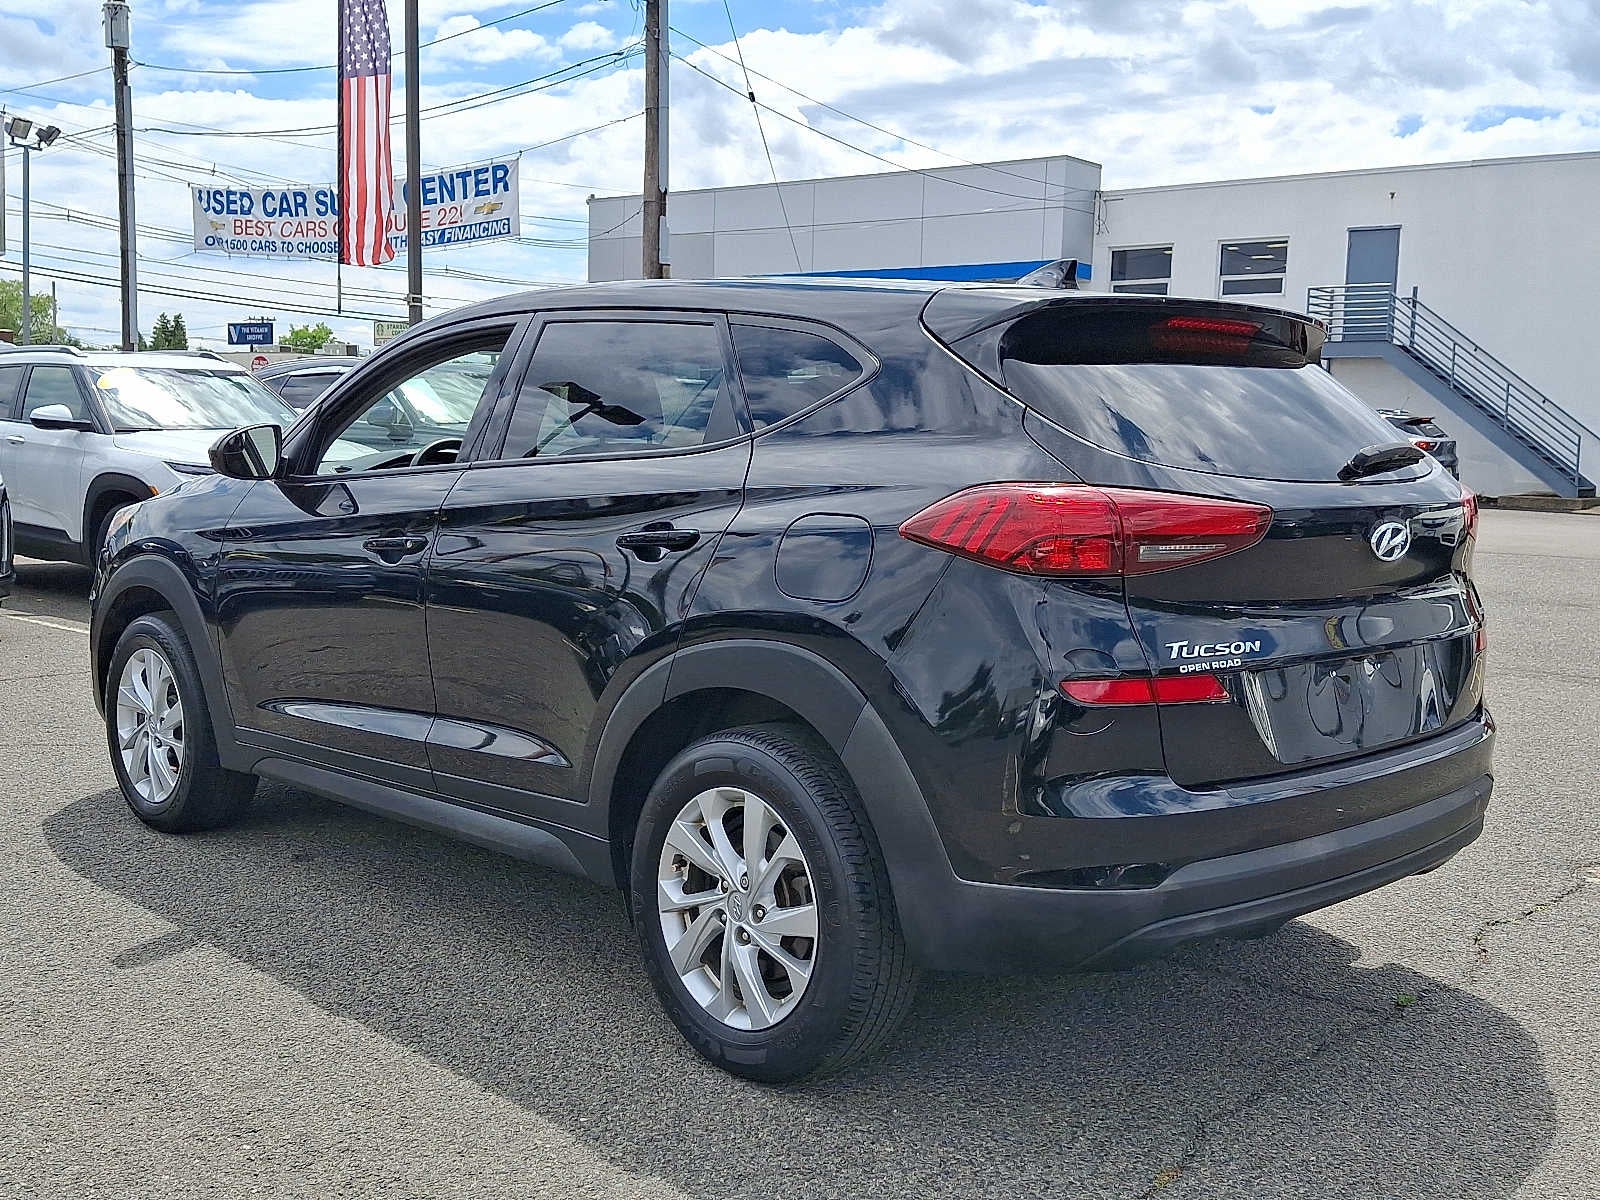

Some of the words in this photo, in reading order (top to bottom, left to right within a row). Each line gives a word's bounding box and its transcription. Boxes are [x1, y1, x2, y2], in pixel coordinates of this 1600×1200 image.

[198, 189, 254, 216] USED
[262, 191, 308, 218] CAR
[403, 164, 510, 206] ENTER
[225, 238, 248, 251] 1500
[250, 239, 278, 252] CARS
[280, 241, 294, 253] TO
[389, 235, 408, 249] ITH
[420, 230, 442, 246] ASY
[443, 219, 510, 243] FINANCING
[233, 219, 276, 237] BEST
[281, 220, 328, 238] CARS
[437, 206, 463, 226] 22!
[1165, 640, 1261, 659] TUCSON
[1179, 662, 1210, 674] OPEN
[1211, 658, 1242, 671] ROAD
